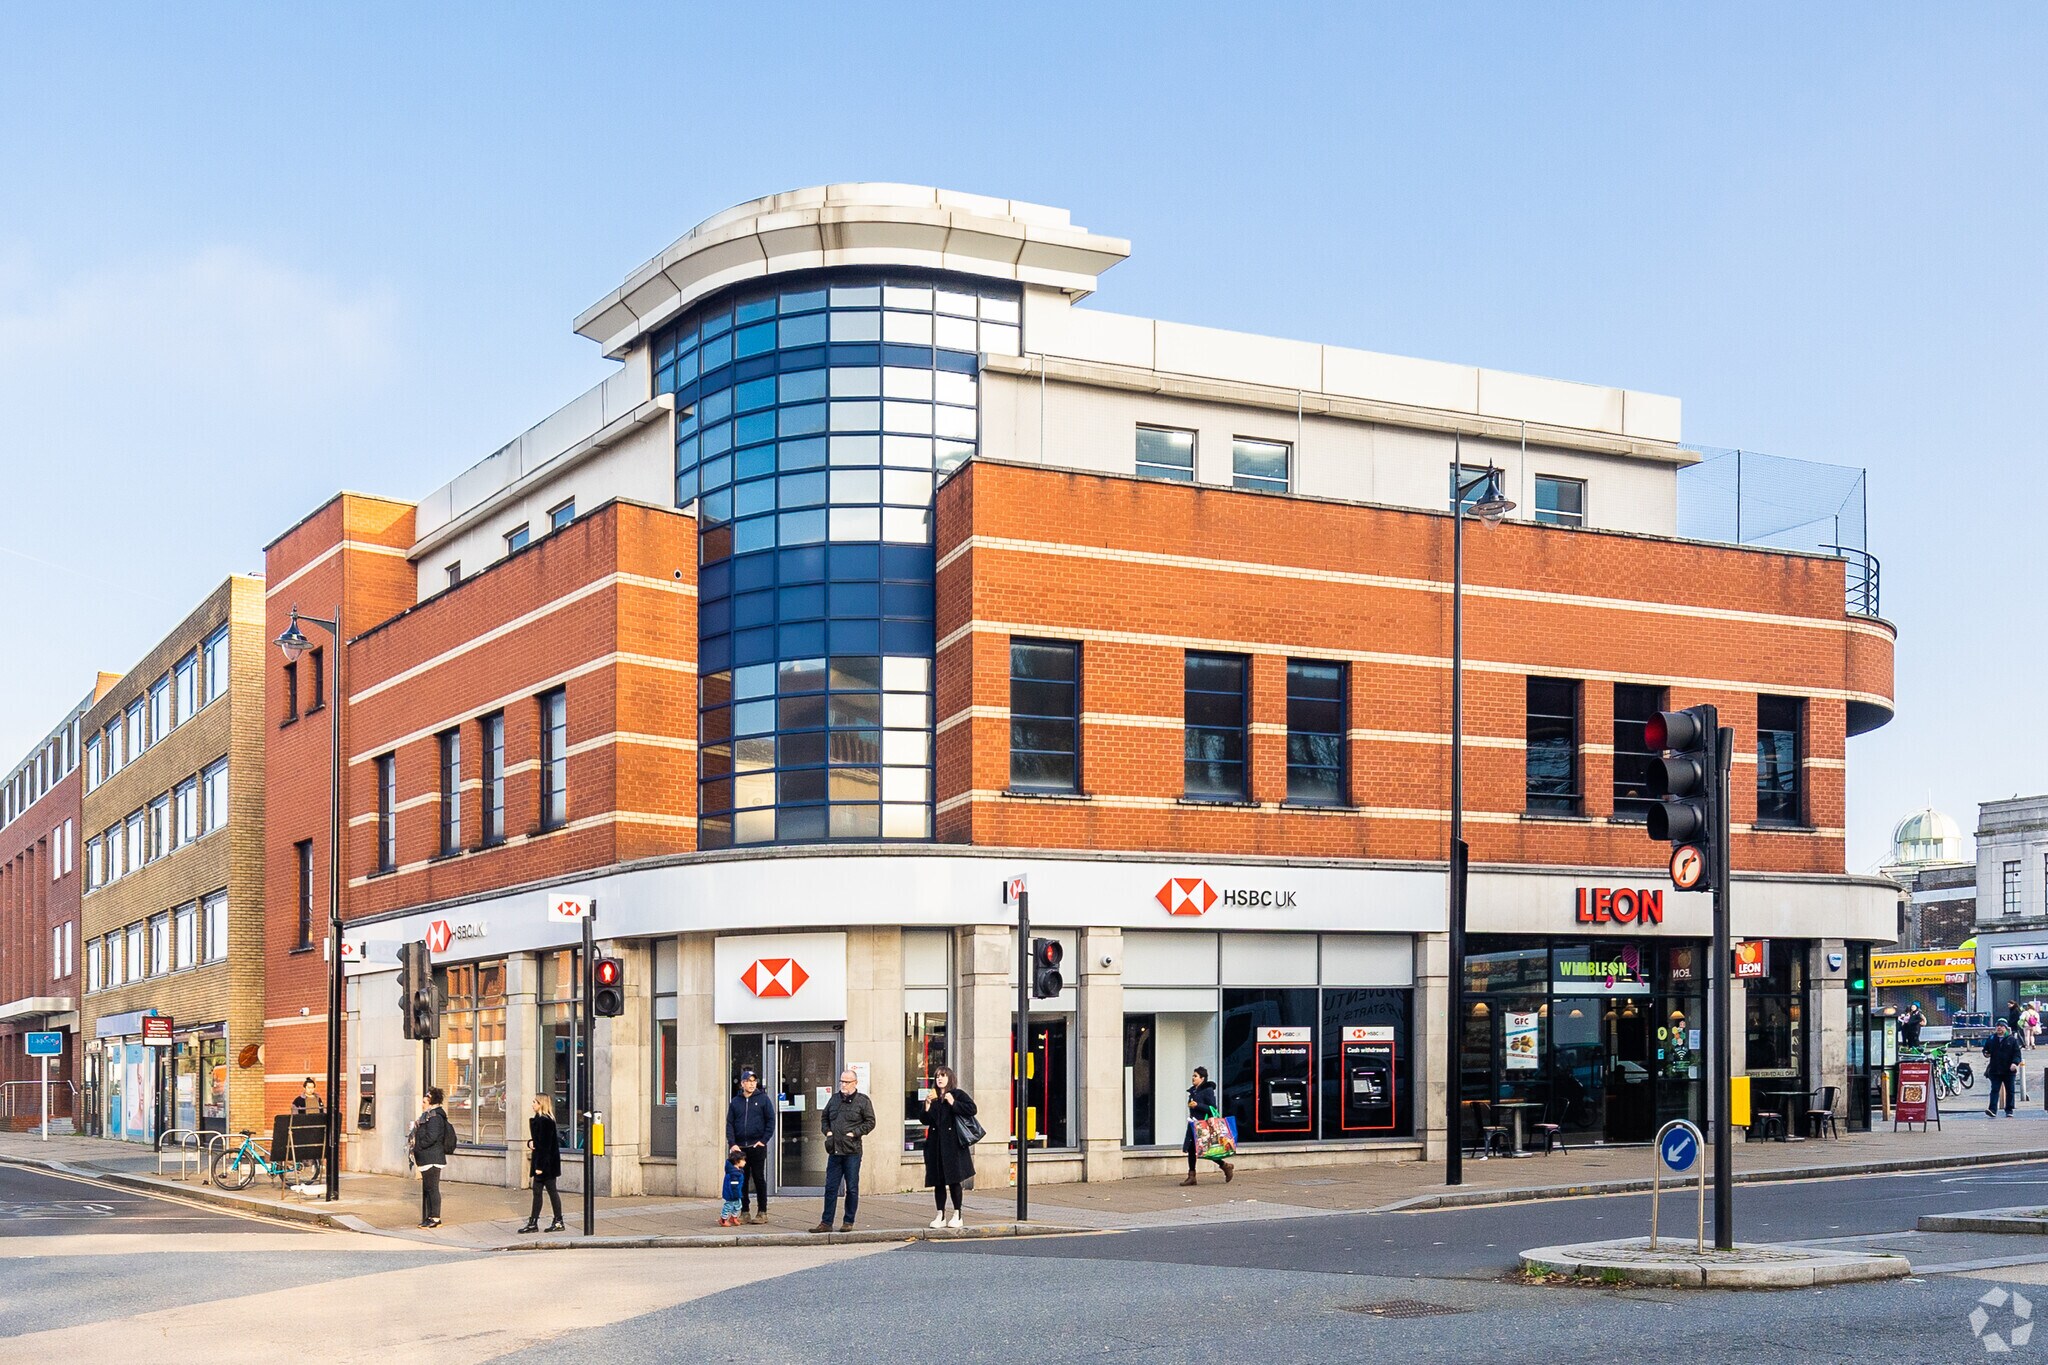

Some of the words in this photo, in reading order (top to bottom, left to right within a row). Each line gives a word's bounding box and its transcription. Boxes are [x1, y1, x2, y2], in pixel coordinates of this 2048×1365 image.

[1224, 890, 1272, 906] HSBC
[1275, 891, 1297, 907] UK
[1576, 888, 1663, 924] LEON
[452, 924, 473, 940] HSBC
[1873, 958, 1940, 969] Wimbledon
[1999, 952, 2048, 961] KRYSTAL
[1560, 962, 1627, 976] WIMBLEON
[1738, 963, 1761, 974] LEON
